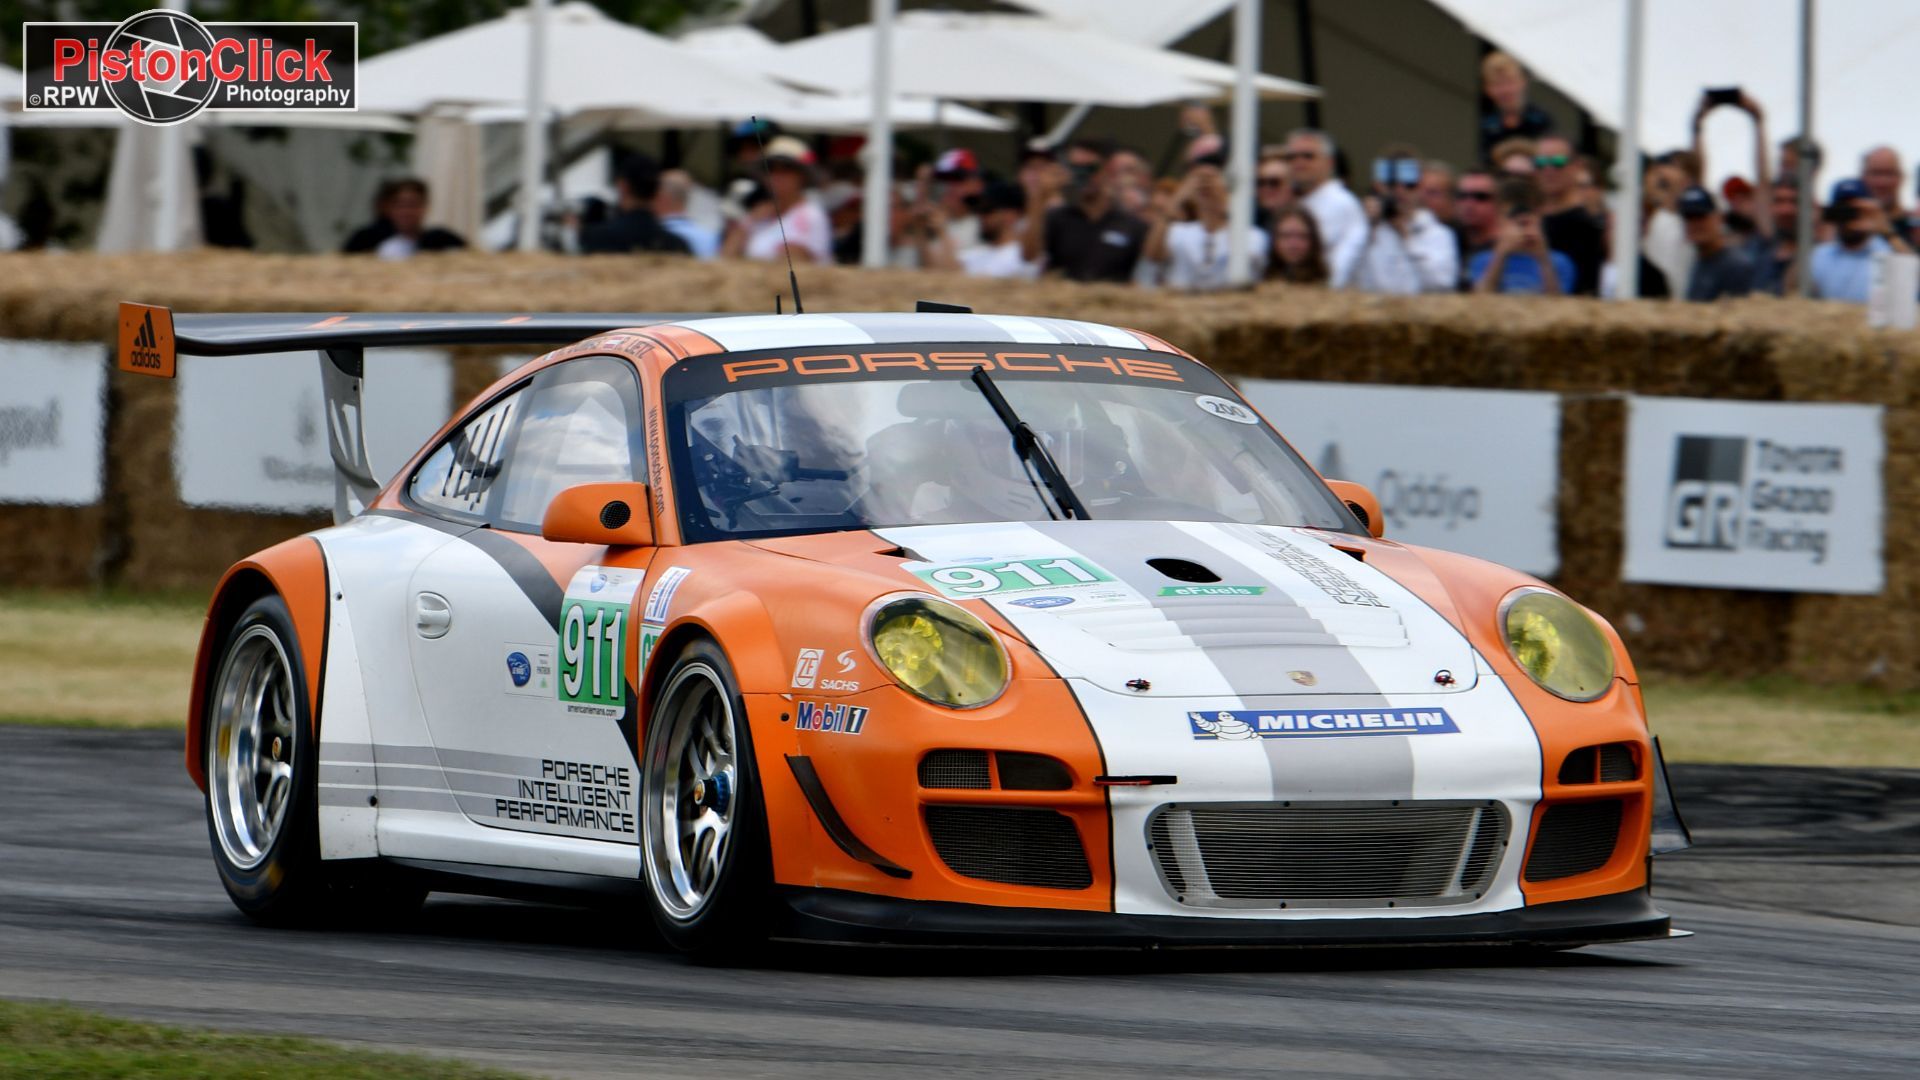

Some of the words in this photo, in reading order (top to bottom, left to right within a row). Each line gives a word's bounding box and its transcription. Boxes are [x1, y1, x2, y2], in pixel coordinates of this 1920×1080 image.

[131, 347, 161, 370] adidas
[722, 352, 1184, 384] PORSCHE
[1206, 401, 1247, 419] 200
[649, 406, 665, 518] www.porsche.com
[1666, 479, 1742, 547] GR
[1747, 518, 1829, 566] Racing
[931, 557, 1100, 593] 911
[1175, 586, 1252, 596] eFuels
[1265, 553, 1354, 605] PORSCHE
[563, 603, 624, 700] 911
[820, 679, 860, 691] SACHS
[796, 701, 847, 733] Mobil
[847, 707, 866, 734] 1
[1258, 712, 1444, 730] MICHELIN
[542, 759, 630, 787] PORSCHE
[518, 778, 630, 810] INTELLIGENT
[496, 799, 634, 833] PERFORMANCE
